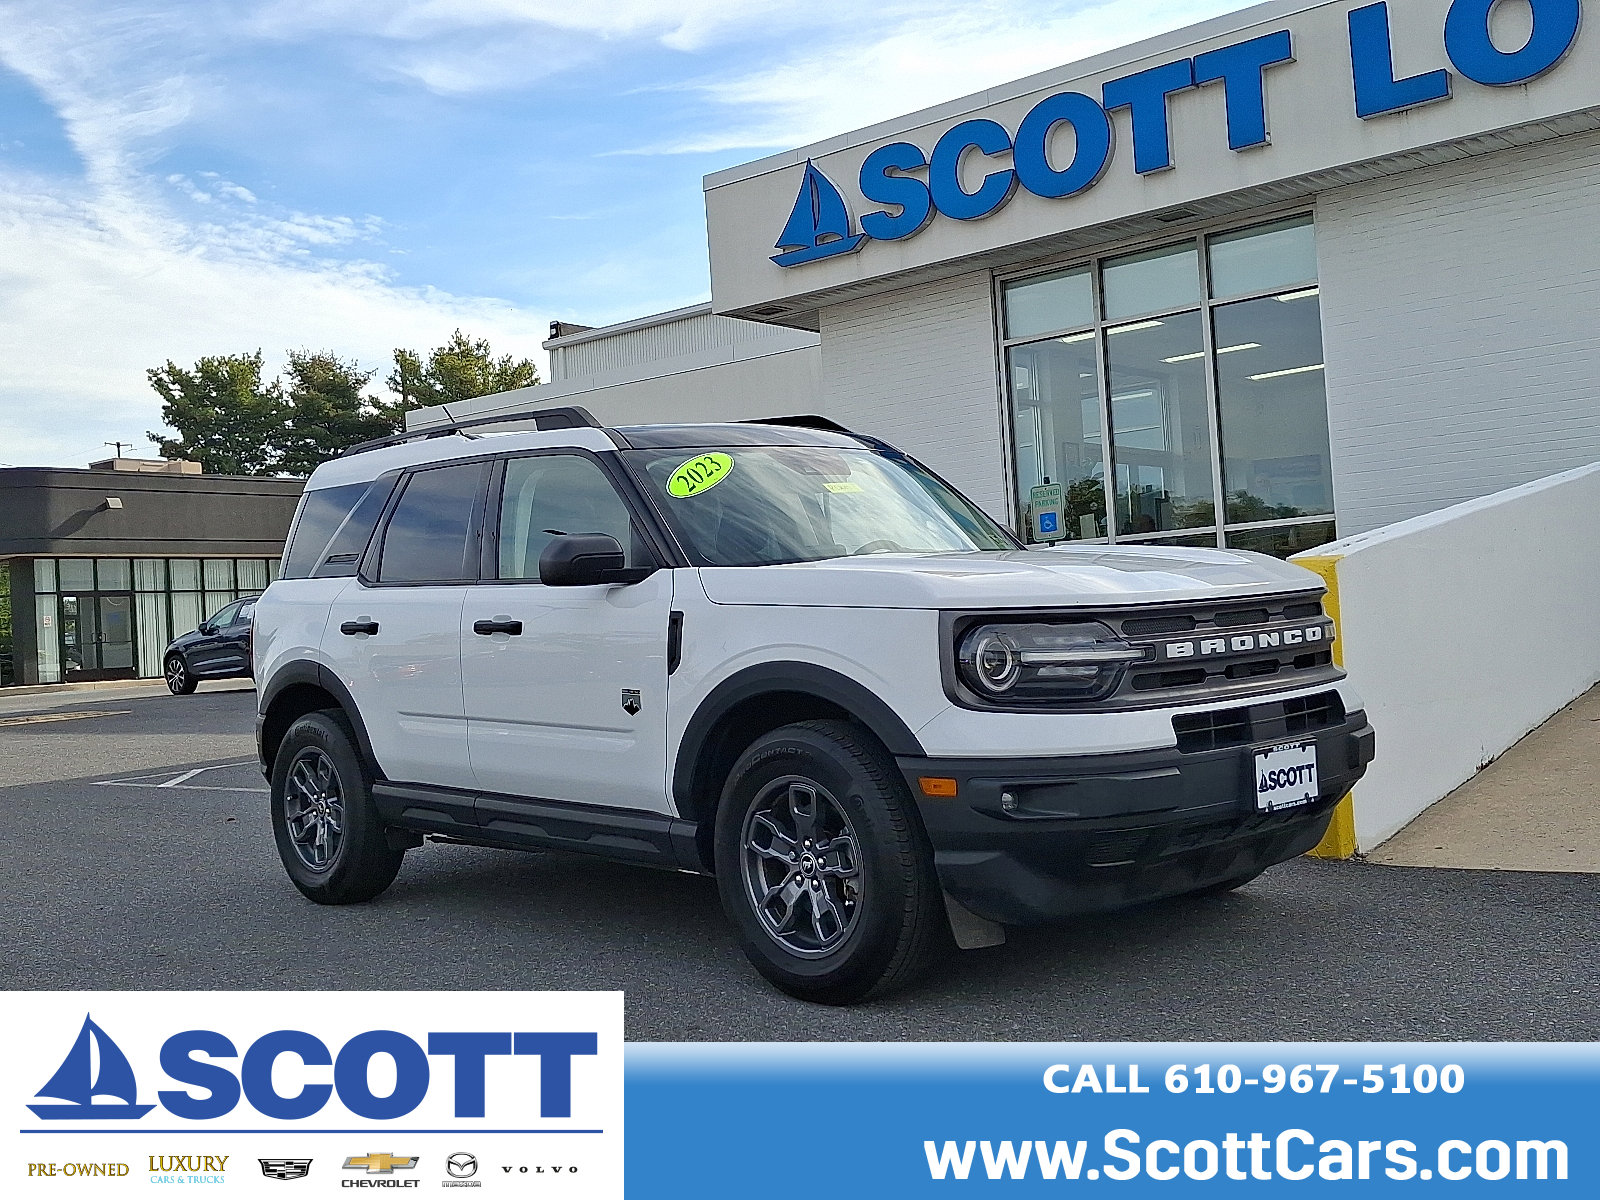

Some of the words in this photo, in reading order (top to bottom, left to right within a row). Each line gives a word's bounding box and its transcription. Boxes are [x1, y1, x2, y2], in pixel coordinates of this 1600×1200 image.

[859, 30, 1294, 241] SCOTT
[1348, 0, 1582, 118] LO
[677, 456, 722, 492] 2023
[1033, 488, 1060, 499] RESERVED
[1035, 498, 1059, 507] PARKING
[1166, 626, 1322, 658] BRONCO
[1268, 763, 1315, 791] SCOTT
